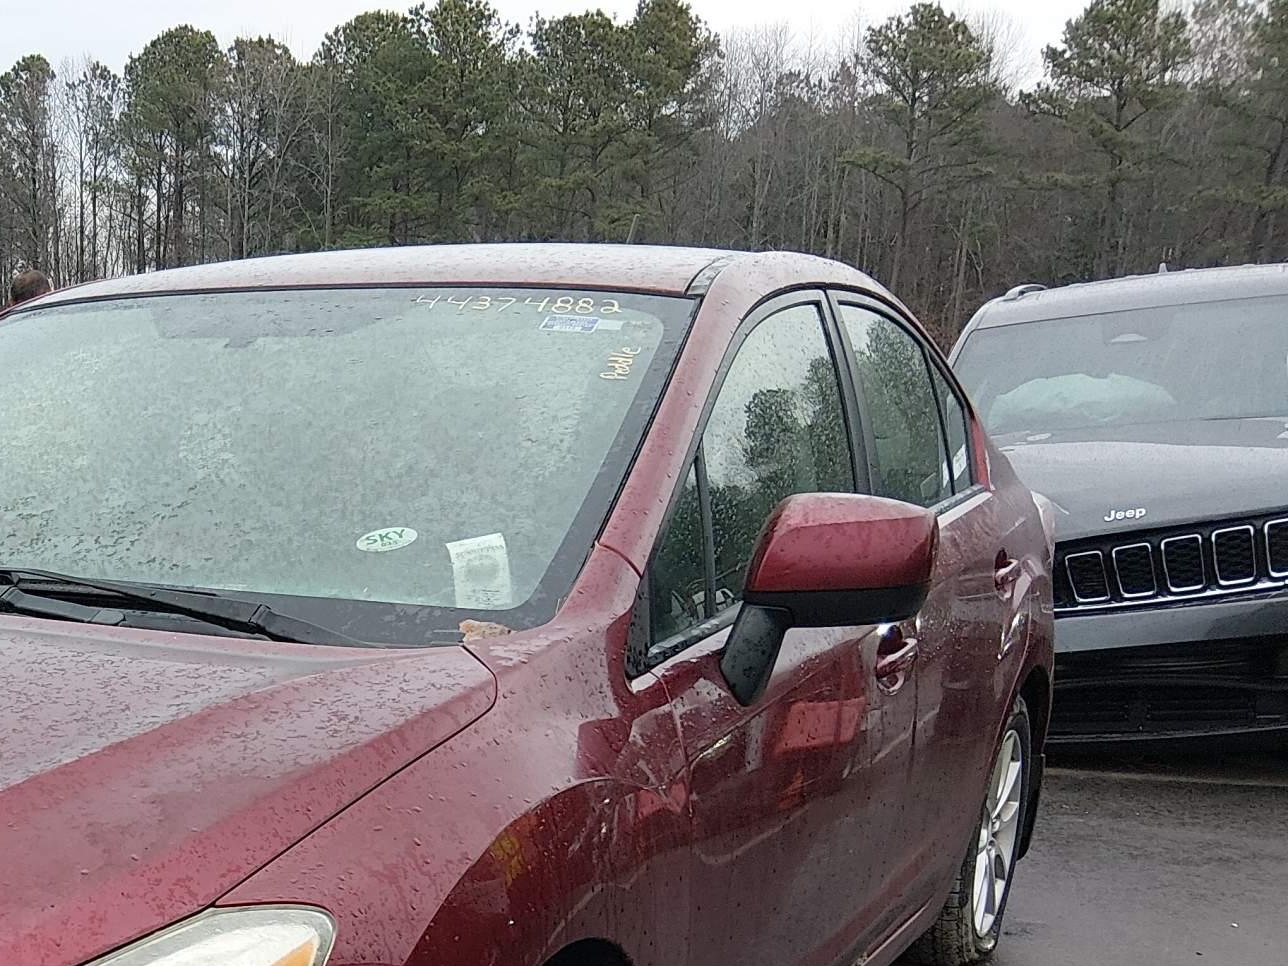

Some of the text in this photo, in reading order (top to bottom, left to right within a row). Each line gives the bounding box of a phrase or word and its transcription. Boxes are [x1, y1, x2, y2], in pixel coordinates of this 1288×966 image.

[414, 295, 623, 314] 44374882
[1103, 507, 1147, 522] Jeep
[365, 528, 406, 545] SKY
